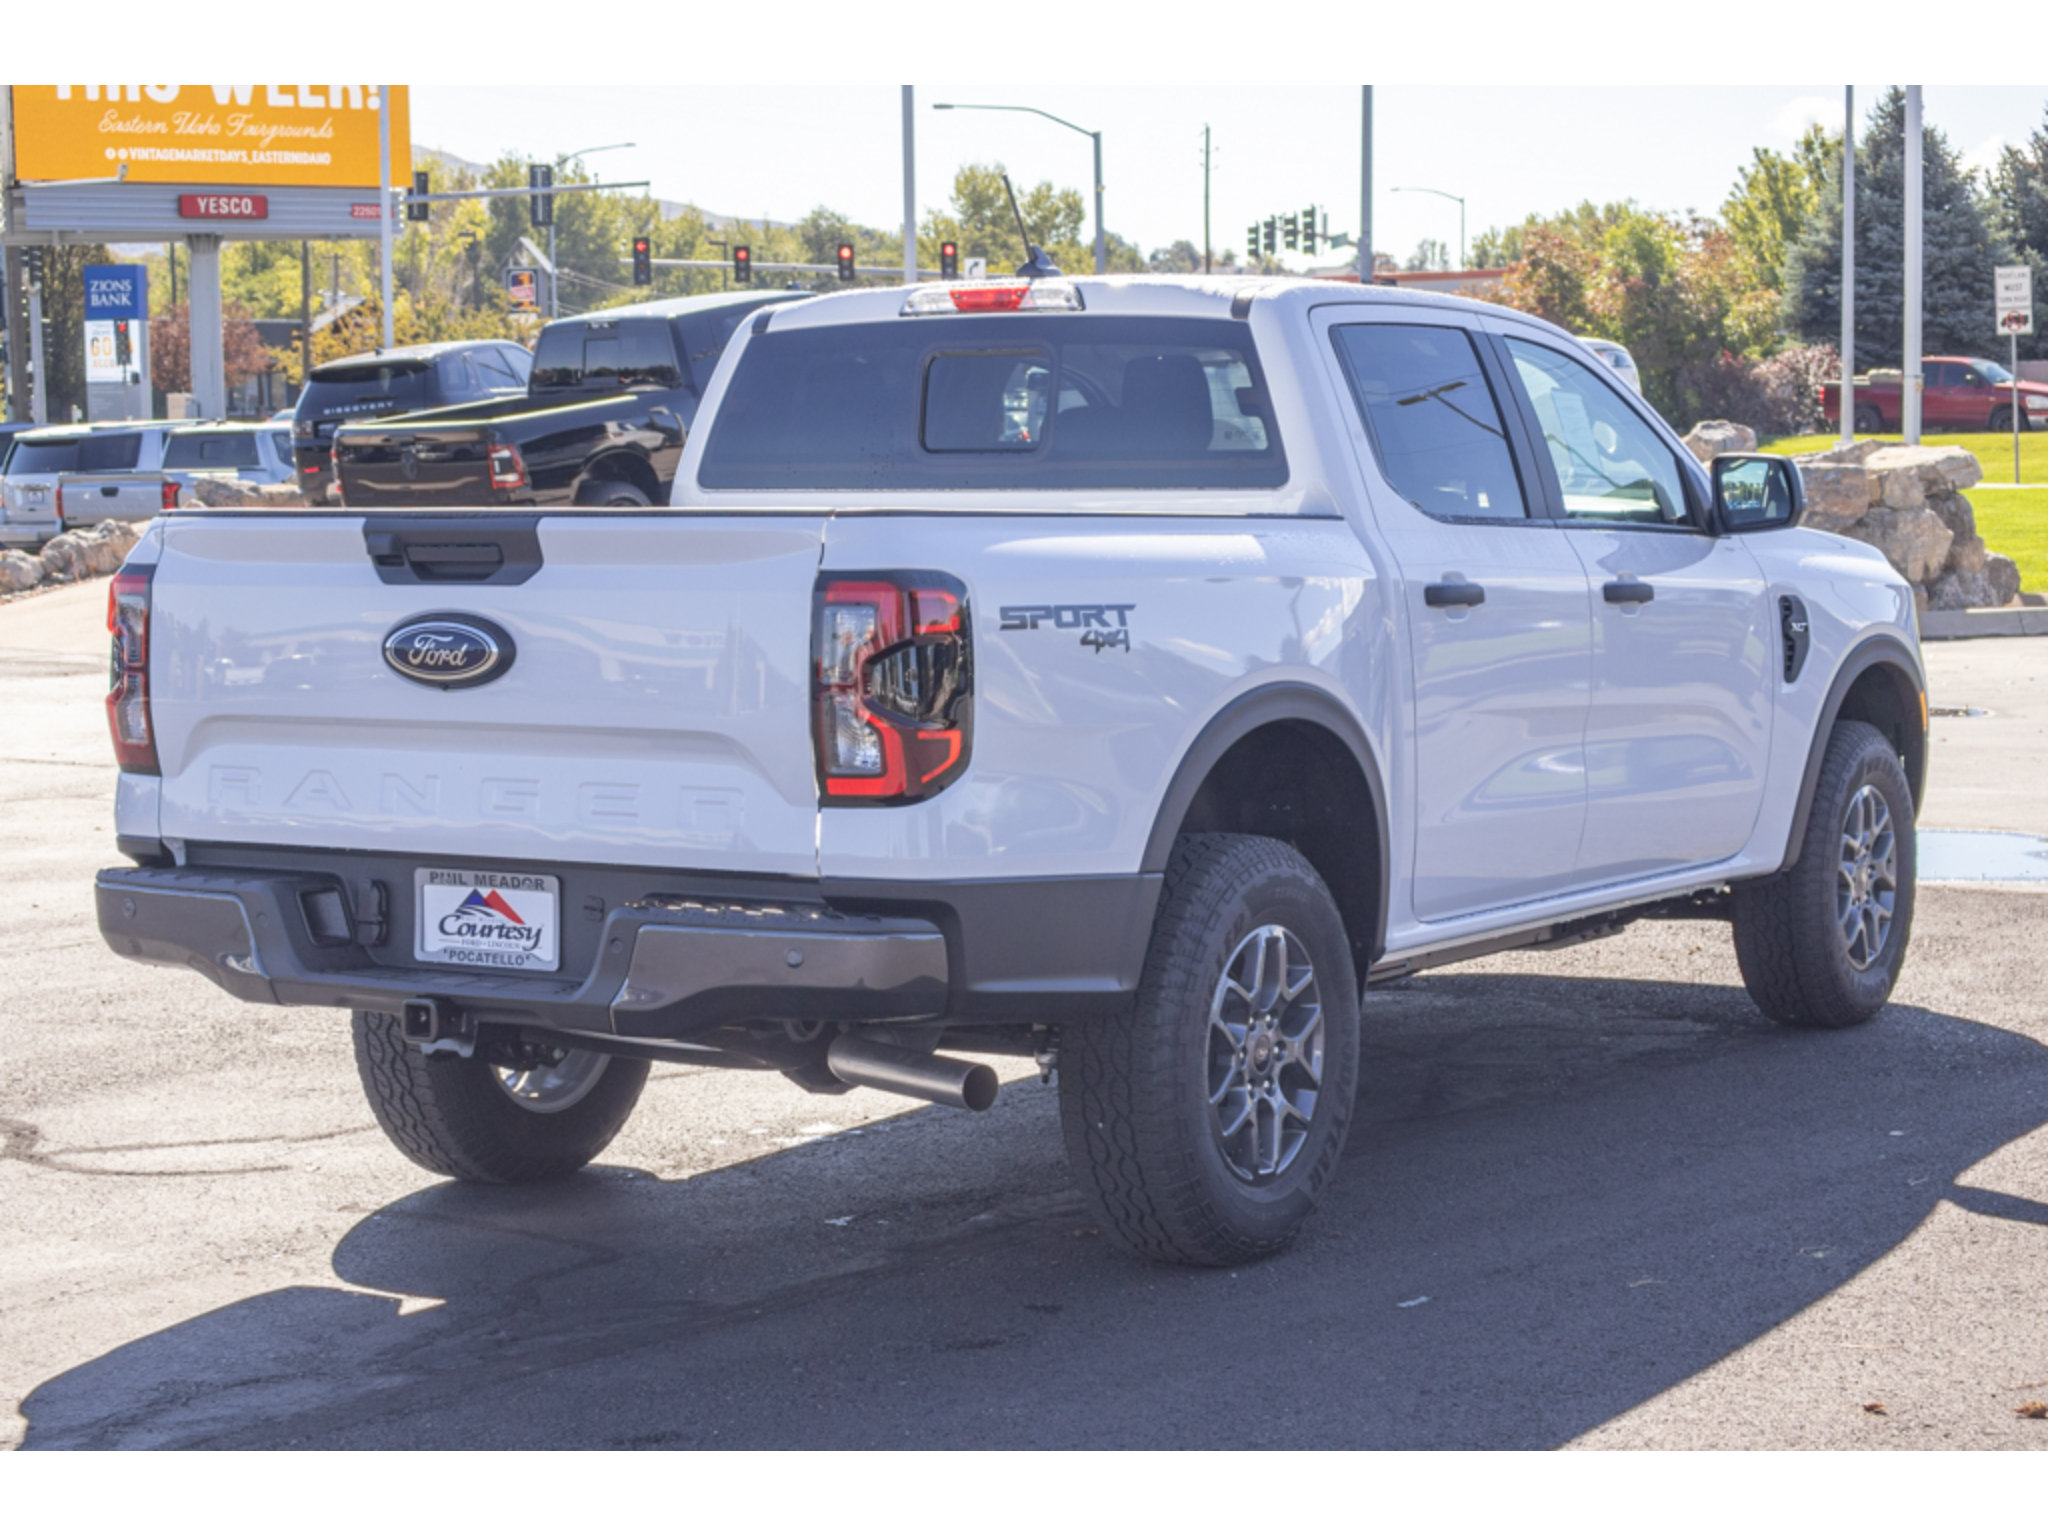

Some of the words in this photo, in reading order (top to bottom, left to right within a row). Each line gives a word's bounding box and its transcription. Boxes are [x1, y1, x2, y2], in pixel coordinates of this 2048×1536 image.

[98, 109, 168, 134] Eastern
[172, 111, 221, 135] Idaho
[225, 112, 334, 148] Fairgrounds
[89, 279, 133, 293] ZIONS
[90, 292, 133, 307] BANK
[323, 401, 394, 415] DISCOVERY
[999, 604, 1137, 631] SPORT
[407, 634, 469, 667] Ford
[207, 764, 744, 832] RANGER
[429, 870, 467, 886] PHIL
[474, 873, 545, 891] MEADOR
[438, 914, 543, 951] Courtesy
